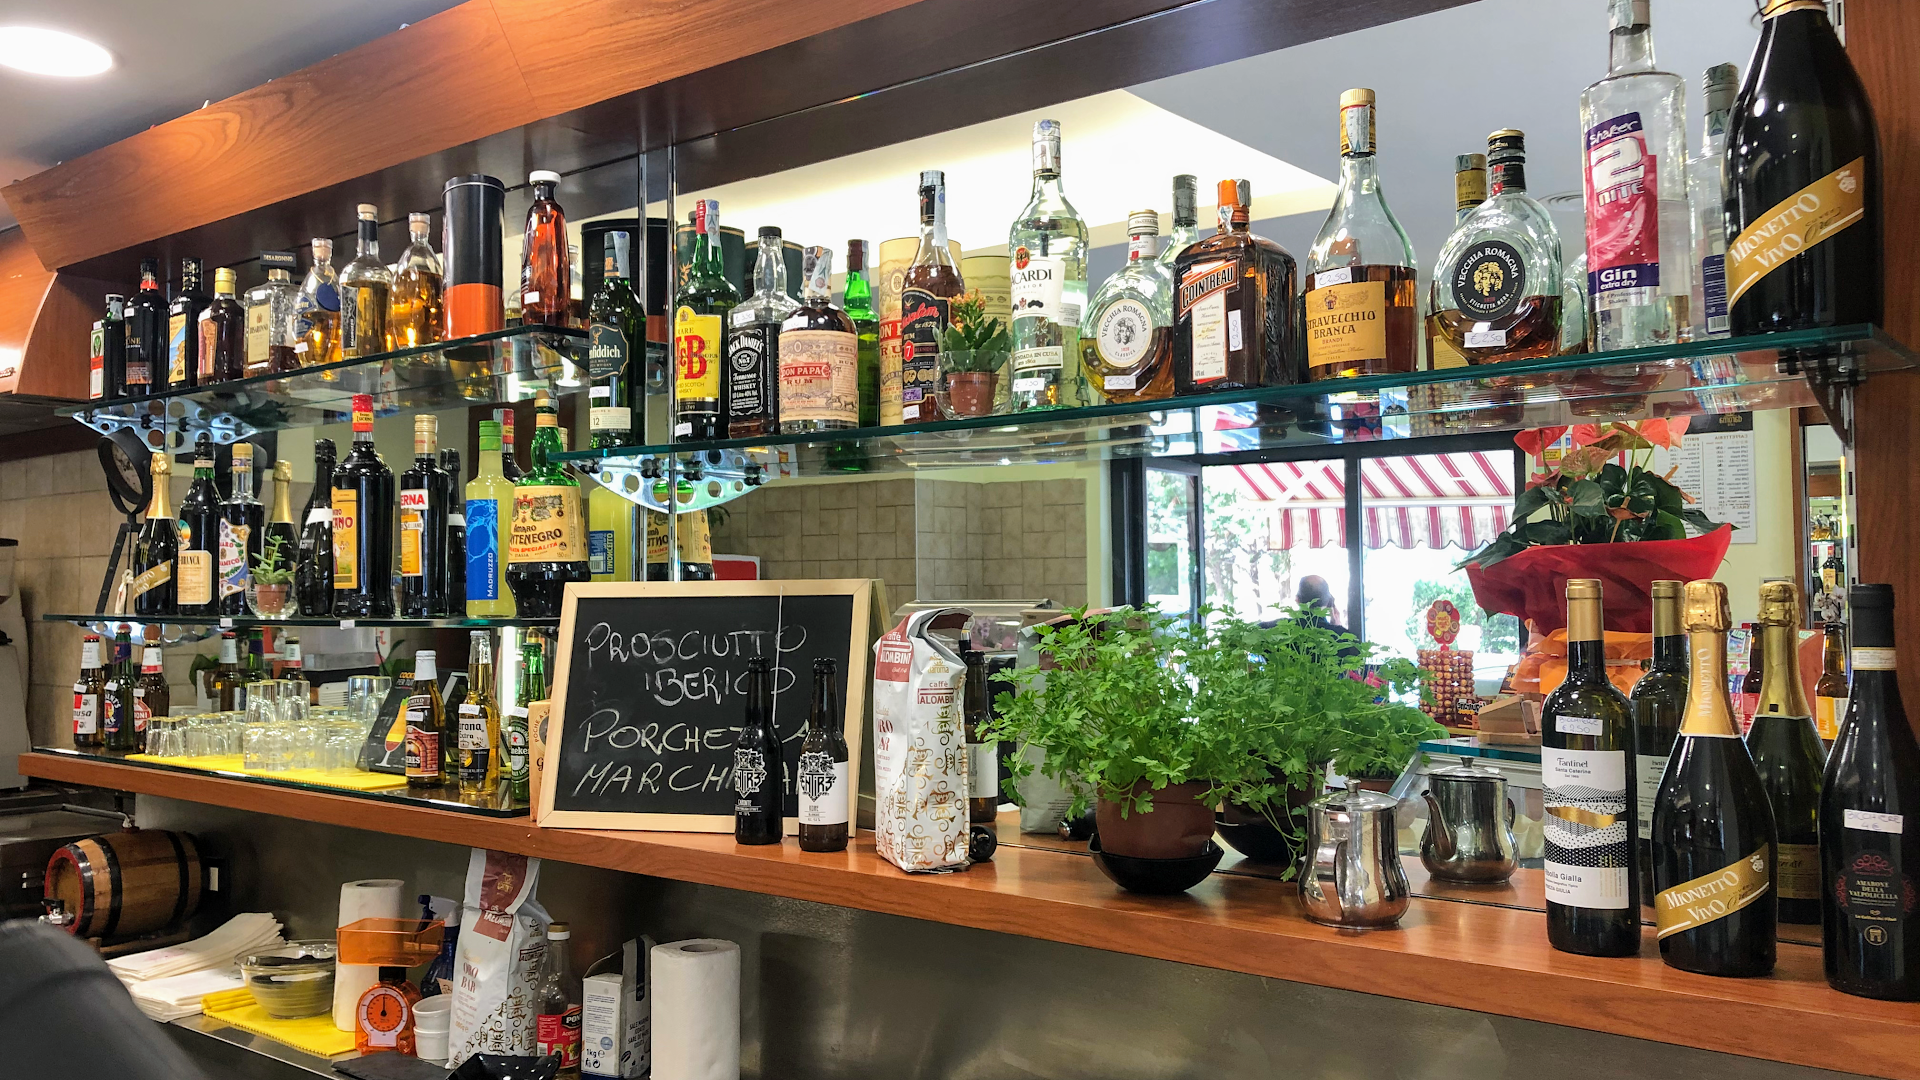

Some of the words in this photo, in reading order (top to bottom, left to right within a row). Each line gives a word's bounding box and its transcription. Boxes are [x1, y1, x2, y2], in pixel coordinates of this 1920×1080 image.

[1589, 120, 1638, 146] shaker
[1590, 136, 1645, 192] 2
[1730, 194, 1820, 268] MIONETTO
[1753, 233, 1803, 268] VIVO
[1458, 250, 1484, 288] VECCHIA
[1485, 247, 1519, 279] ROMAGNA
[1600, 269, 1637, 280] Gin
[1182, 266, 1234, 309] COINTREAU
[1600, 281, 1620, 290] extra
[1621, 280, 1637, 289] dry
[1102, 306, 1122, 338] VECCHIA
[1122, 304, 1148, 333] ROMAGNA
[1314, 325, 1357, 340] BRANCA
[1322, 337, 1343, 345] BRANDY
[728, 338, 741, 358] JACK
[906, 345, 912, 357] 7
[797, 366, 821, 375] PAPA
[733, 382, 757, 391] WHISKEY
[592, 416, 600, 426] 12
[486, 552, 494, 598] MADRUZZO
[585, 622, 807, 669] PROSCIUTTO
[644, 665, 797, 707] IBERICO
[929, 680, 949, 688] caffè
[1697, 648, 1713, 719] MIONETTO
[533, 720, 541, 743] POCHE
[1560, 873, 1583, 883] Gialla
[1855, 879, 1890, 888] AMARONE
[1555, 886, 1572, 895] GIULIA
[1664, 870, 1740, 910] MIONETTO
[1848, 889, 1899, 900] VALPOLICELLA
[1686, 899, 1726, 923] VIVO
[462, 962, 479, 979] ORO
[460, 975, 477, 993] BAR
[629, 1022, 638, 1031] SALE
[586, 1048, 597, 1059] 1kg
